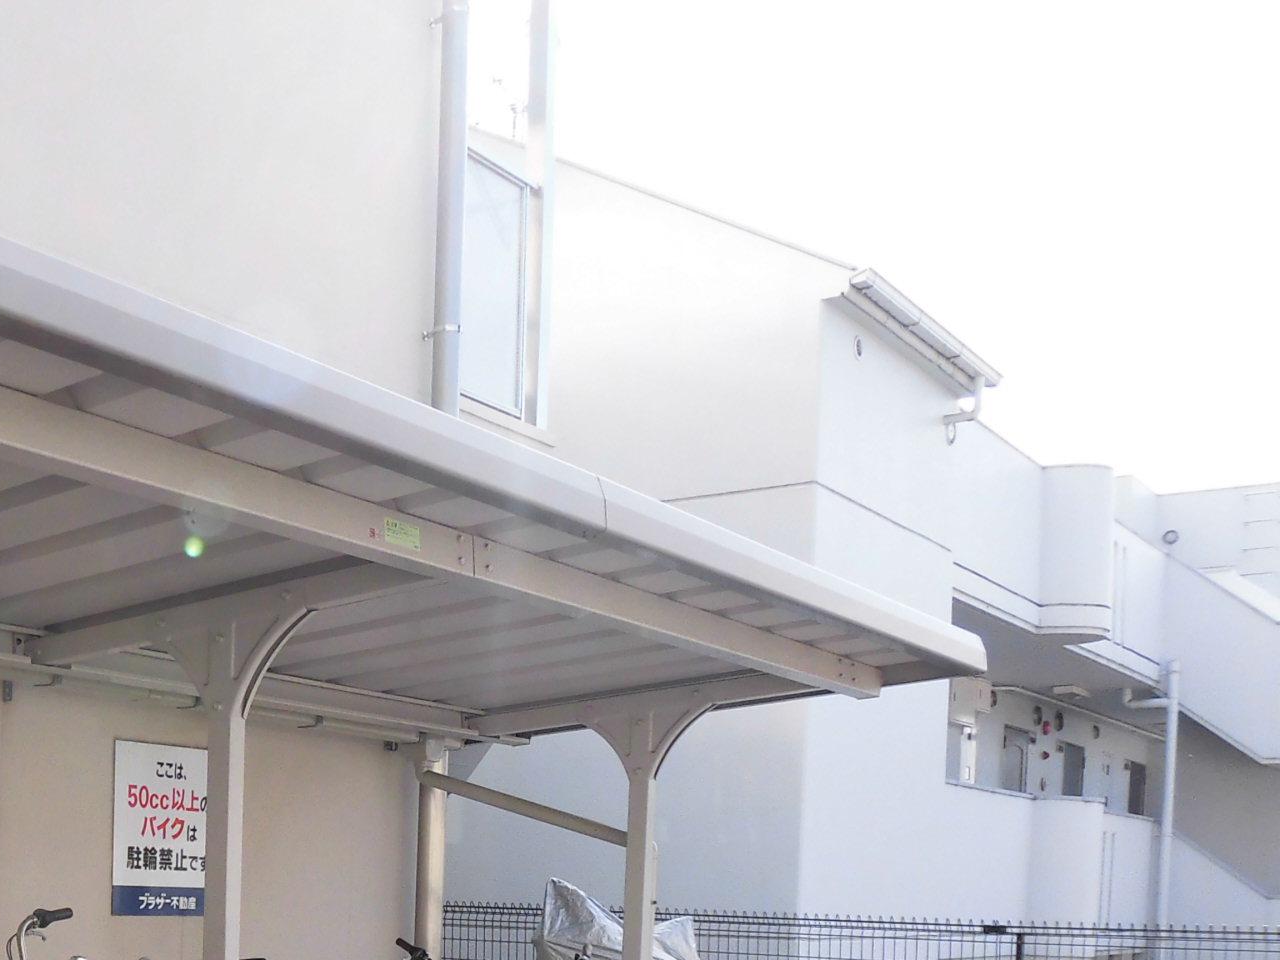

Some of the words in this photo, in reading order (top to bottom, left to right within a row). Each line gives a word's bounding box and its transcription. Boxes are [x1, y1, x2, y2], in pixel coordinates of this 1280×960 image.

[141, 816, 198, 842] バイクは
[138, 892, 197, 910] ブラザー不動産
